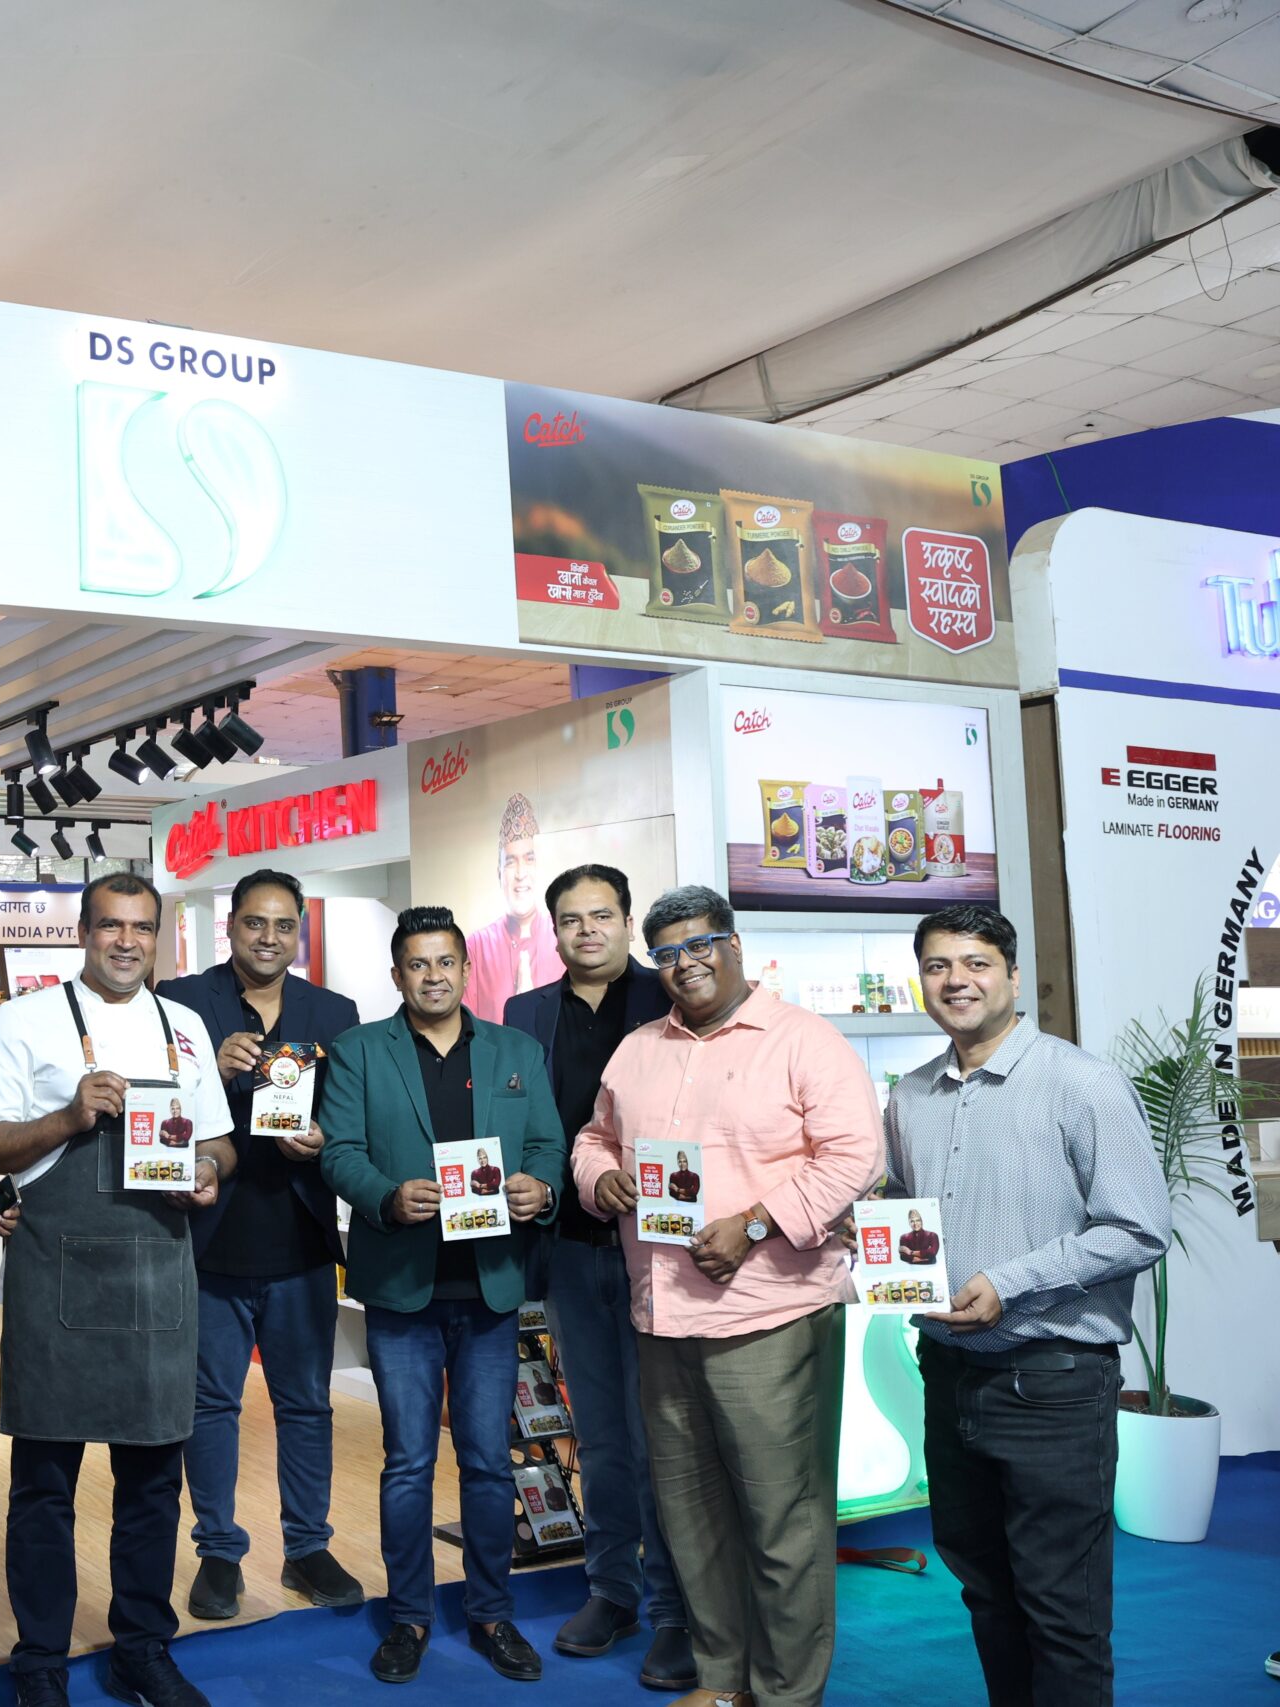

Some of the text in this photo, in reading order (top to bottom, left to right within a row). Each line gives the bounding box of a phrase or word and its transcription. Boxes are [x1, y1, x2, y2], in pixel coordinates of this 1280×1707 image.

[89, 331, 276, 385] DS GROUP
[523, 410, 585, 447] Catch
[547, 583, 572, 600] खाना
[918, 574, 981, 609] स्वादको
[928, 607, 977, 637] रहस्य
[734, 707, 771, 734] Catch
[421, 741, 469, 794] Catch
[1128, 770, 1218, 796] EGGER
[853, 789, 878, 810] Catch
[1128, 793, 1219, 813] Made in GERMANY
[165, 779, 377, 879] Catch KITCHEN
[1103, 822, 1221, 842] LAMINATE FLOORING
[35, 902, 47, 914] छ
[2, 926, 43, 939] INDIA
[47, 927, 76, 939] PVT.
[1214, 846, 1266, 1029] GERMANY
